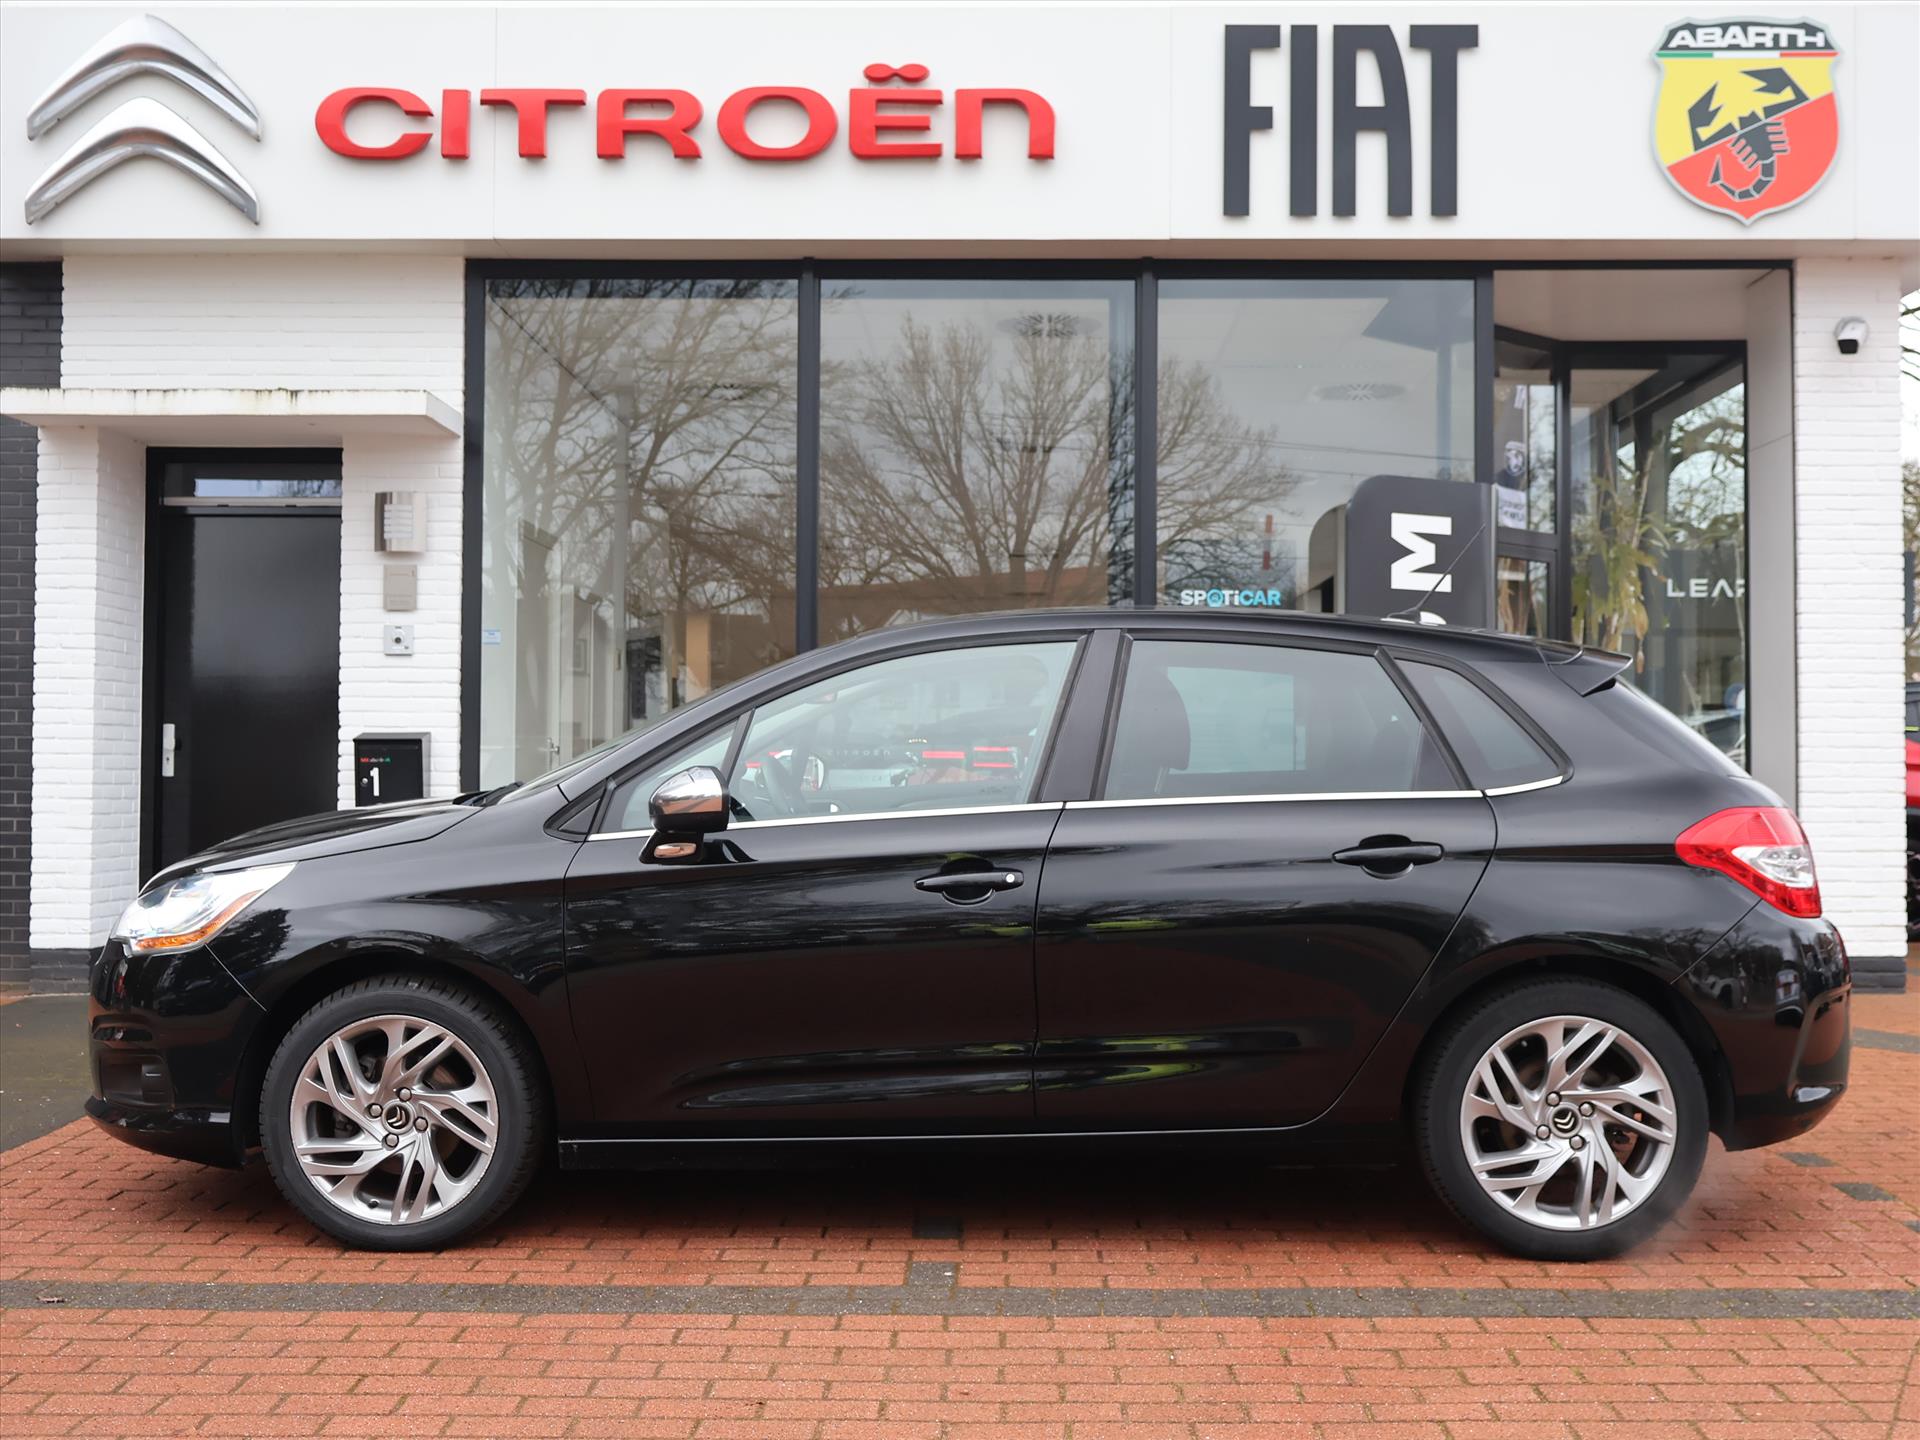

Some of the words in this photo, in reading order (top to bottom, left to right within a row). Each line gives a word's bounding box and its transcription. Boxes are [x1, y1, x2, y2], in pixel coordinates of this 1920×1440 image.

[1667, 24, 1826, 49] ABARTH
[315, 62, 1056, 161] CITROËN
[1224, 24, 1479, 217] FIAT
[369, 766, 380, 797] 1
